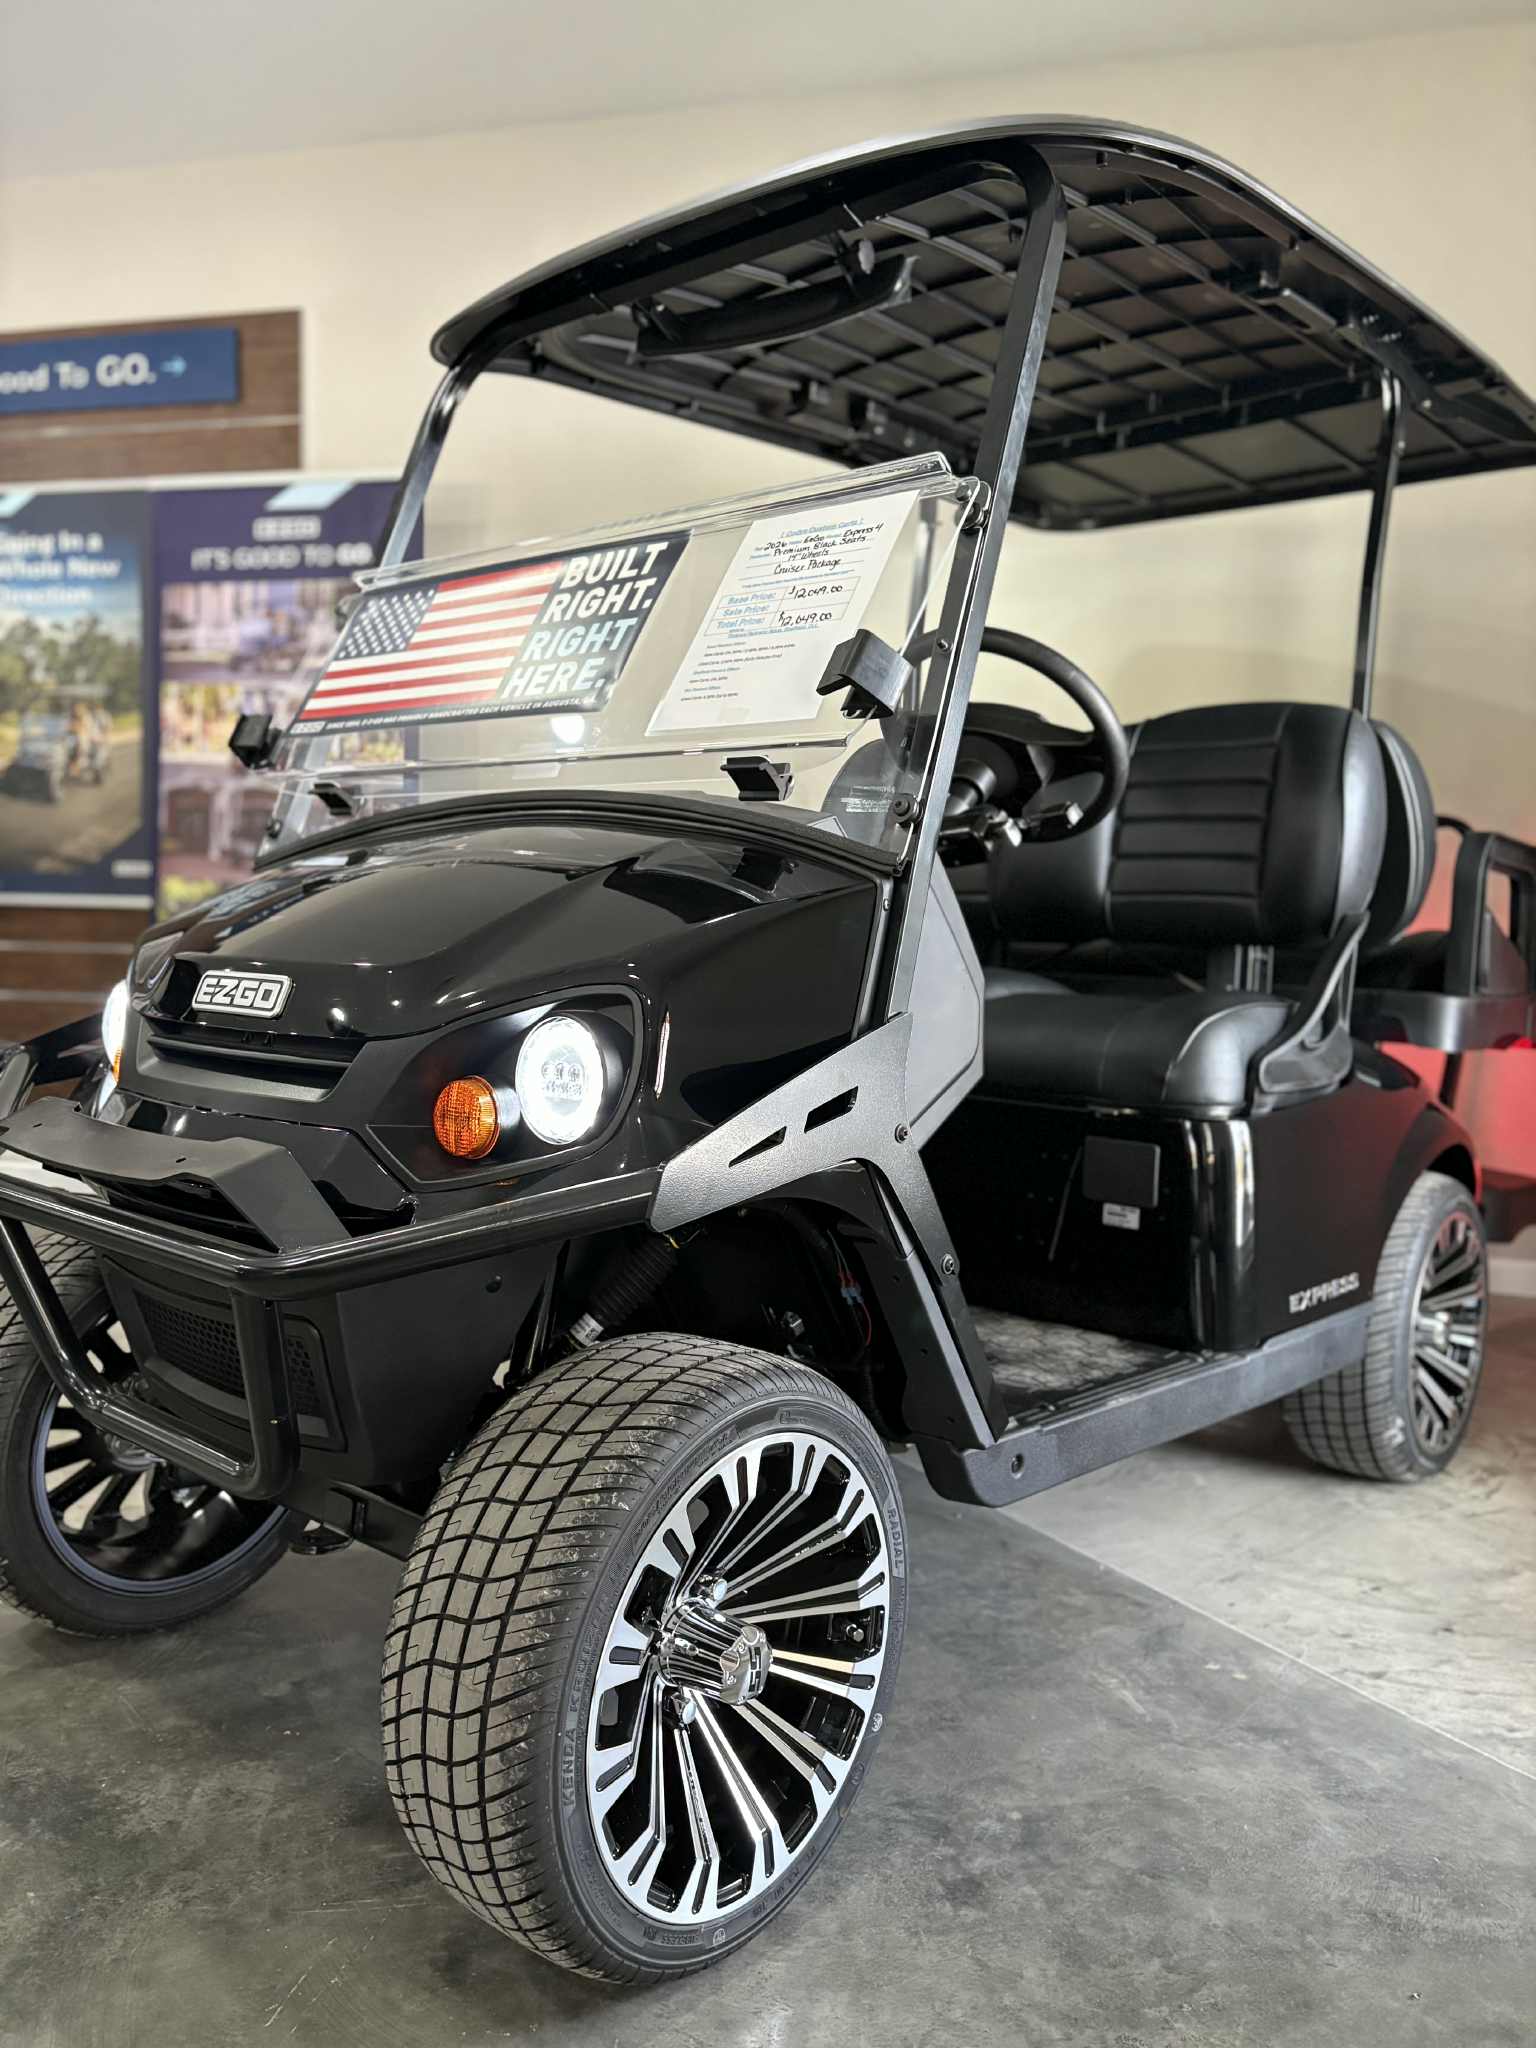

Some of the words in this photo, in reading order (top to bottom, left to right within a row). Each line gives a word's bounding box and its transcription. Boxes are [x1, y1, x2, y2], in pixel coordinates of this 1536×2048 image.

[53, 360, 90, 391] To
[96, 352, 157, 387] GO.
[774, 546, 810, 557] Premium
[814, 541, 837, 550] Black
[839, 535, 866, 545] Seats
[843, 527, 873, 538] Express
[560, 541, 669, 589] BUILT
[807, 558, 842, 571] Package
[541, 577, 657, 624] RIGHT.
[521, 617, 638, 662] RIGHT
[501, 657, 606, 698] HERE.
[196, 977, 282, 1009] EZGO
[1288, 1271, 1361, 1314] EXPRESS
[887, 1508, 904, 1569] RADIAL
[562, 1728, 576, 1807] KENDA
